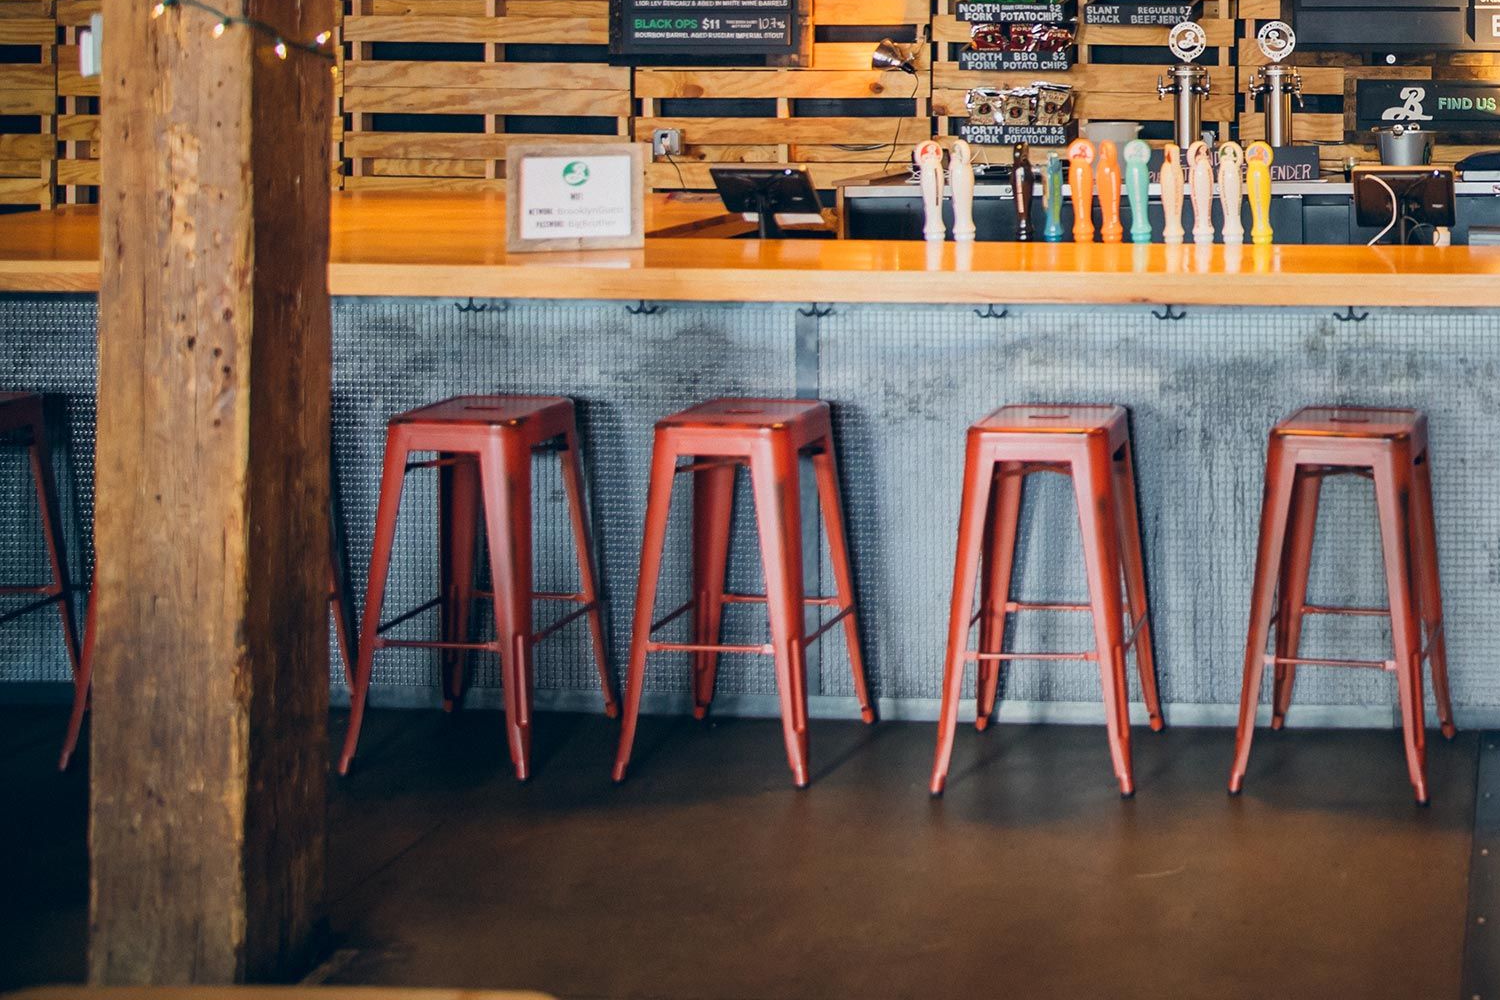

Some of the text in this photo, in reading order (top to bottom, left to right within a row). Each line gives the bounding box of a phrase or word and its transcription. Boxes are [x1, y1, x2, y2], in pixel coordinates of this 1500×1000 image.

[959, 4, 1061, 12] NORTH $2
[1086, 6, 1119, 14] SLANT
[965, 13, 1063, 21] FORK POTATO CHIPS
[1087, 15, 1190, 24] SHACK BEEF JERKY
[634, 19, 672, 29] BLACK
[675, 19, 698, 29] OPS
[702, 18, 720, 30] $11
[962, 52, 1066, 61] NORTH BBQ $2
[968, 62, 1068, 70] FORK POTATO CHIPS
[1438, 97, 1472, 110] FIND
[1476, 98, 1496, 111] US
[962, 126, 1064, 134] NORTH REGULAR $2
[967, 135, 1065, 144] FORK POTATO CHIPS
